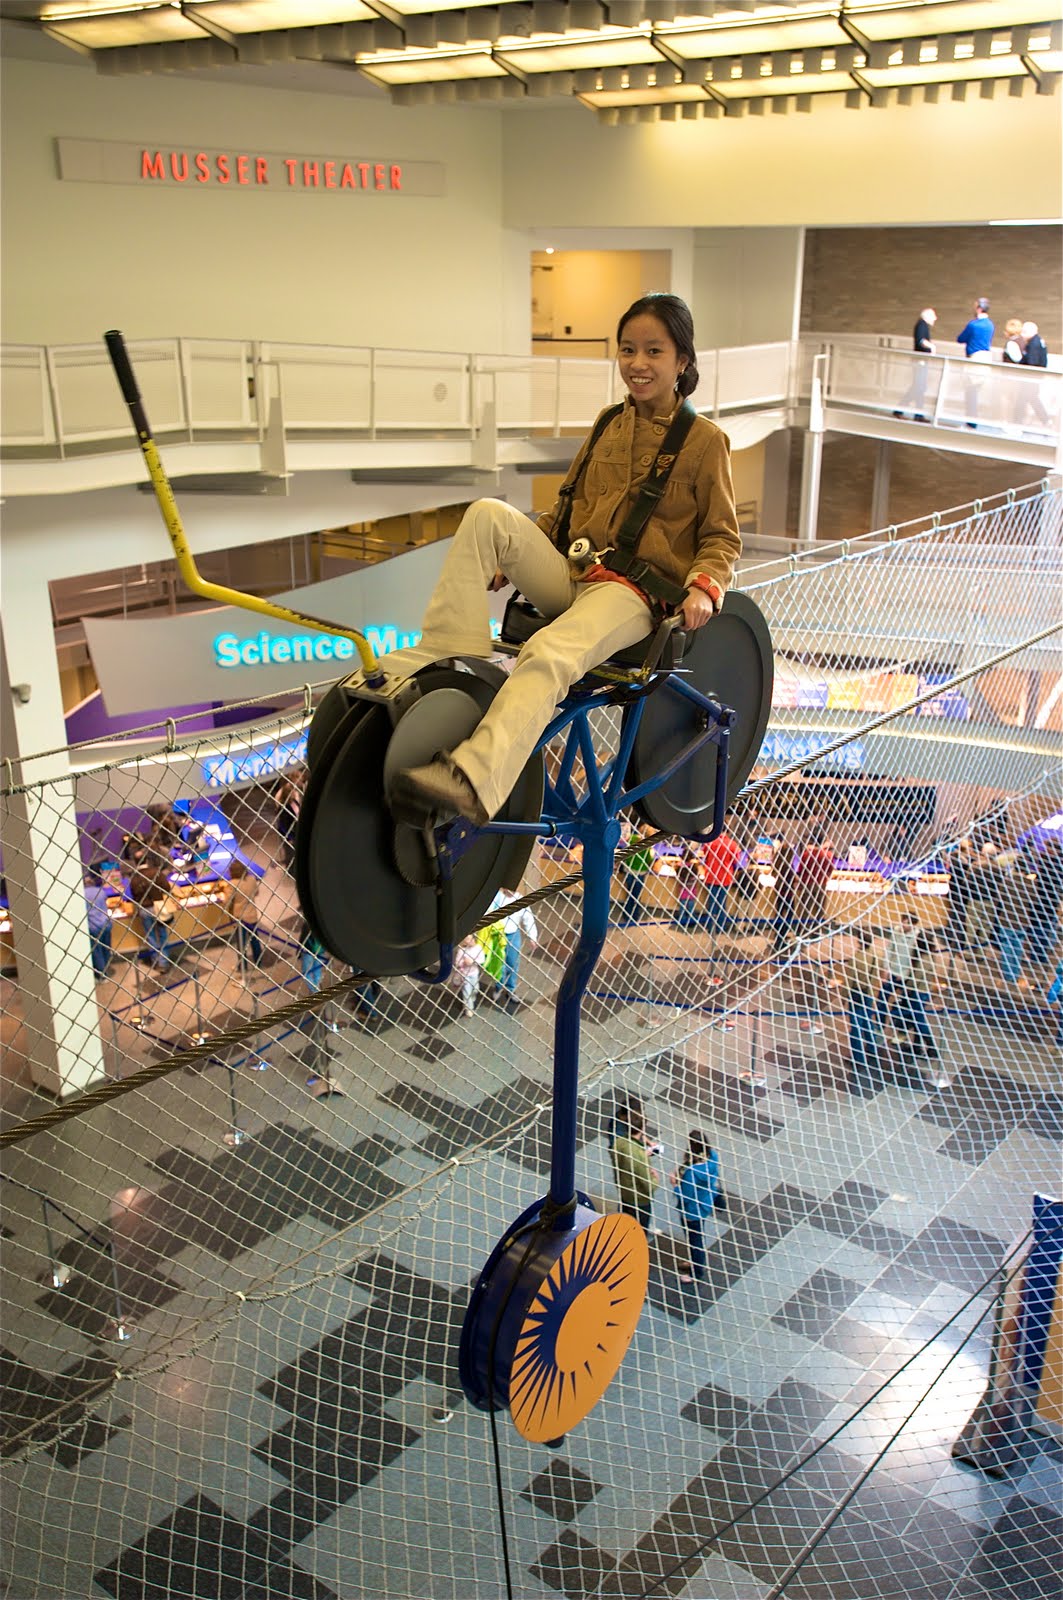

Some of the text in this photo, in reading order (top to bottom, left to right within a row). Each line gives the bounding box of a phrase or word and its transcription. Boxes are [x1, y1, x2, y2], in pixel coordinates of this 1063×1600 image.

[140, 149, 403, 191] MUSSER THEATER
[215, 630, 353, 669] Science
